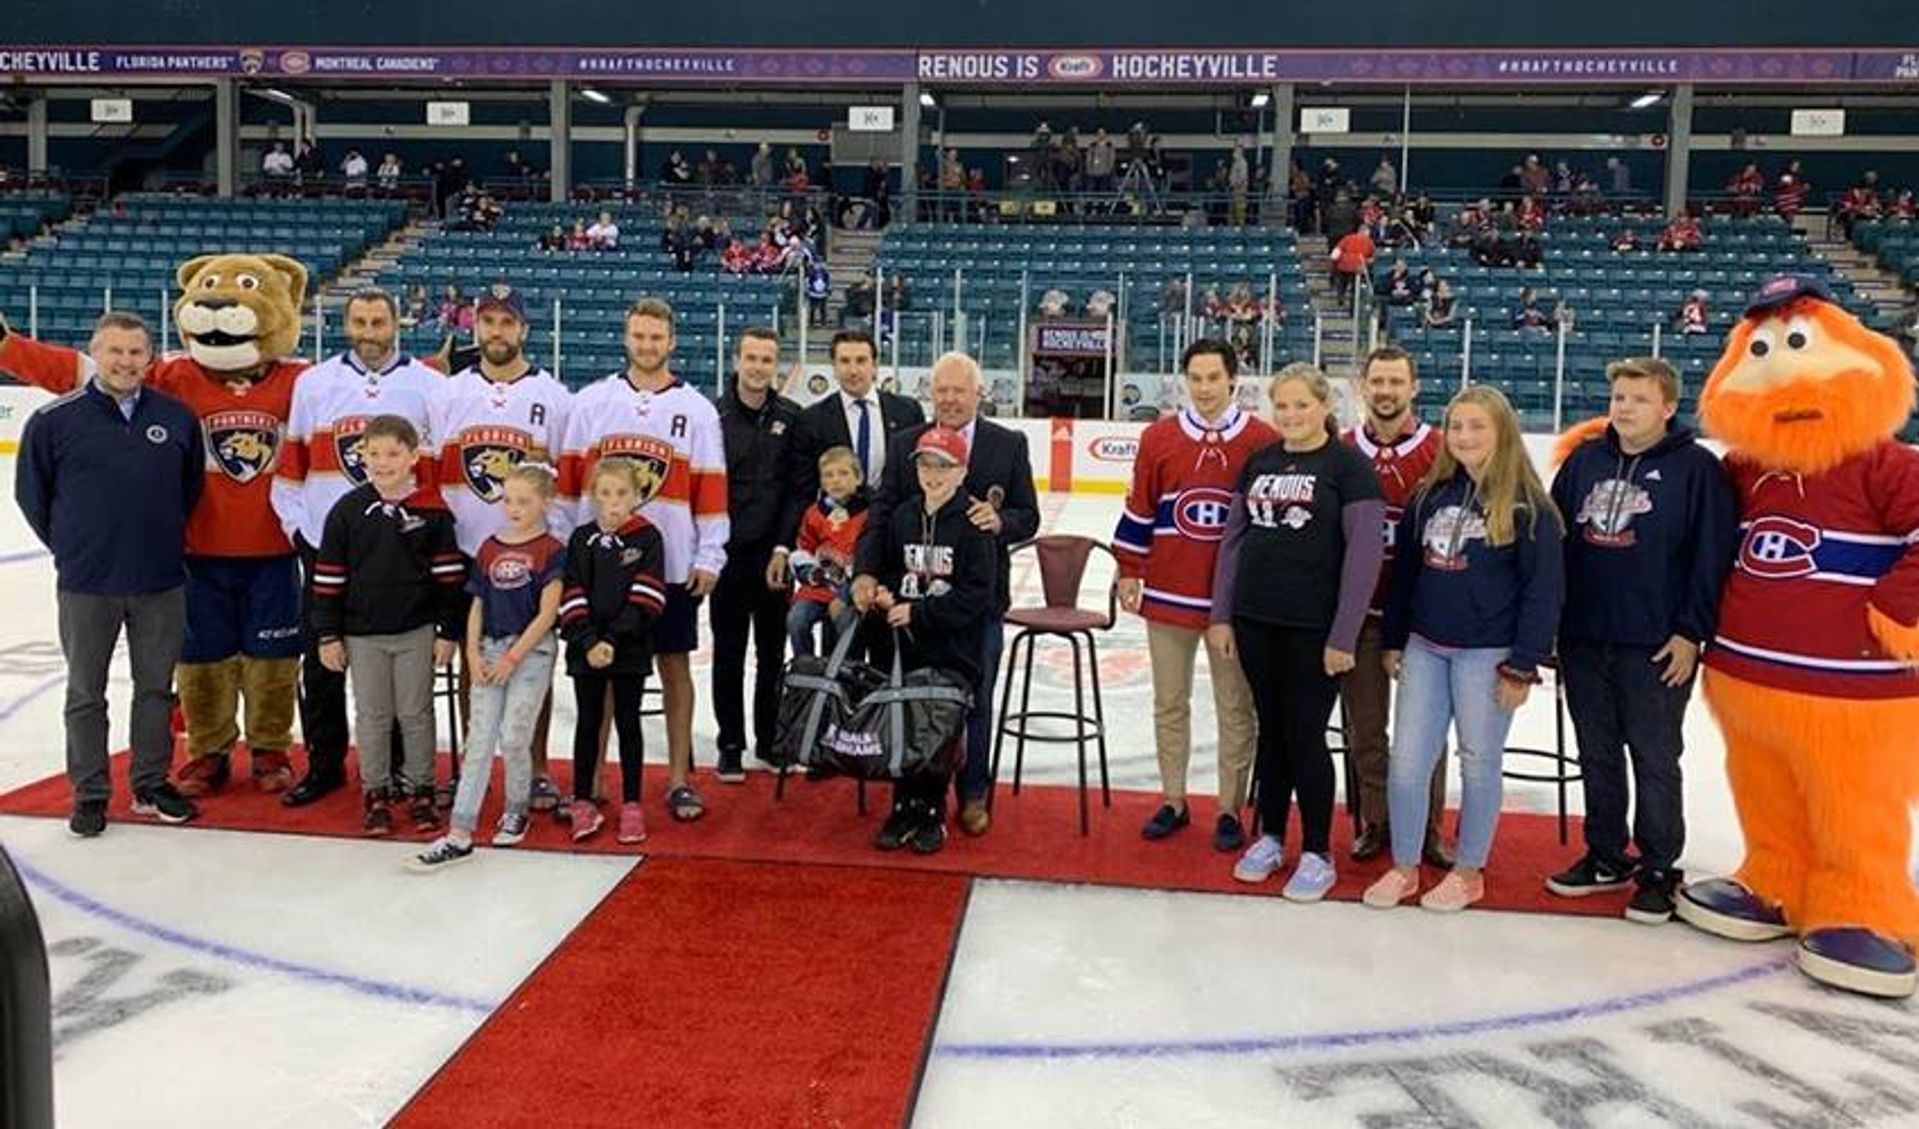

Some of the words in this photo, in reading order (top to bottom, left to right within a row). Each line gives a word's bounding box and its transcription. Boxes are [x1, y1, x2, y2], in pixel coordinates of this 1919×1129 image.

[115, 56, 165, 69] FLORIDA
[315, 57, 372, 71] MONTREAL
[918, 55, 1009, 78] RENOUS
[1016, 55, 1039, 78] IS
[1112, 54, 1278, 78] HOCKEYVILLE
[530, 402, 546, 426] A
[670, 414, 688, 438] A
[464, 429, 525, 446] FLORIDA
